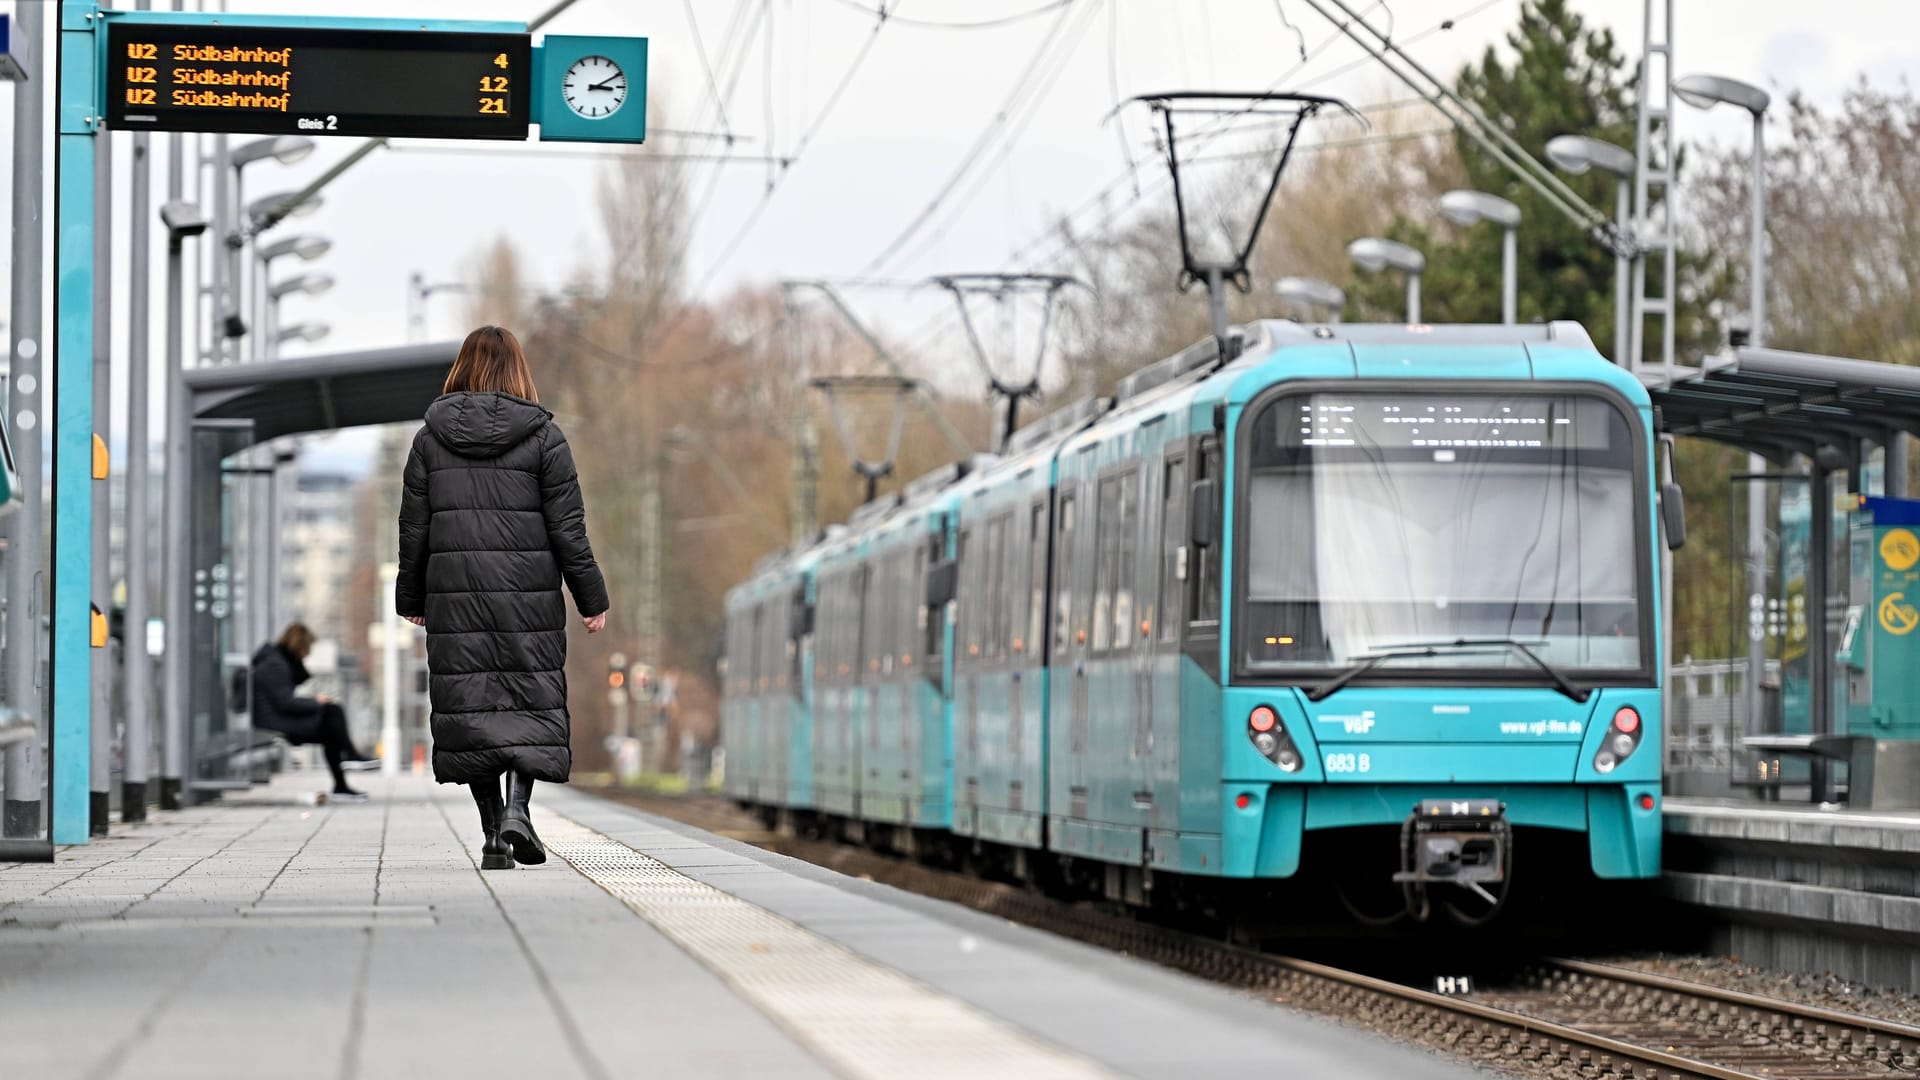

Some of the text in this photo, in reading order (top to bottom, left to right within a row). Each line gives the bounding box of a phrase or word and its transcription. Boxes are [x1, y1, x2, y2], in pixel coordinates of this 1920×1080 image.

[127, 43, 509, 69] U2 Südbahnhof 4
[127, 66, 509, 92] U2 Südbahnhof 12
[126, 88, 508, 114] U2 Südbahnhof 21
[298, 114, 338, 130] Gleis 2
[1326, 752, 1371, 773] 683 B
[1437, 975, 1469, 994] H1
